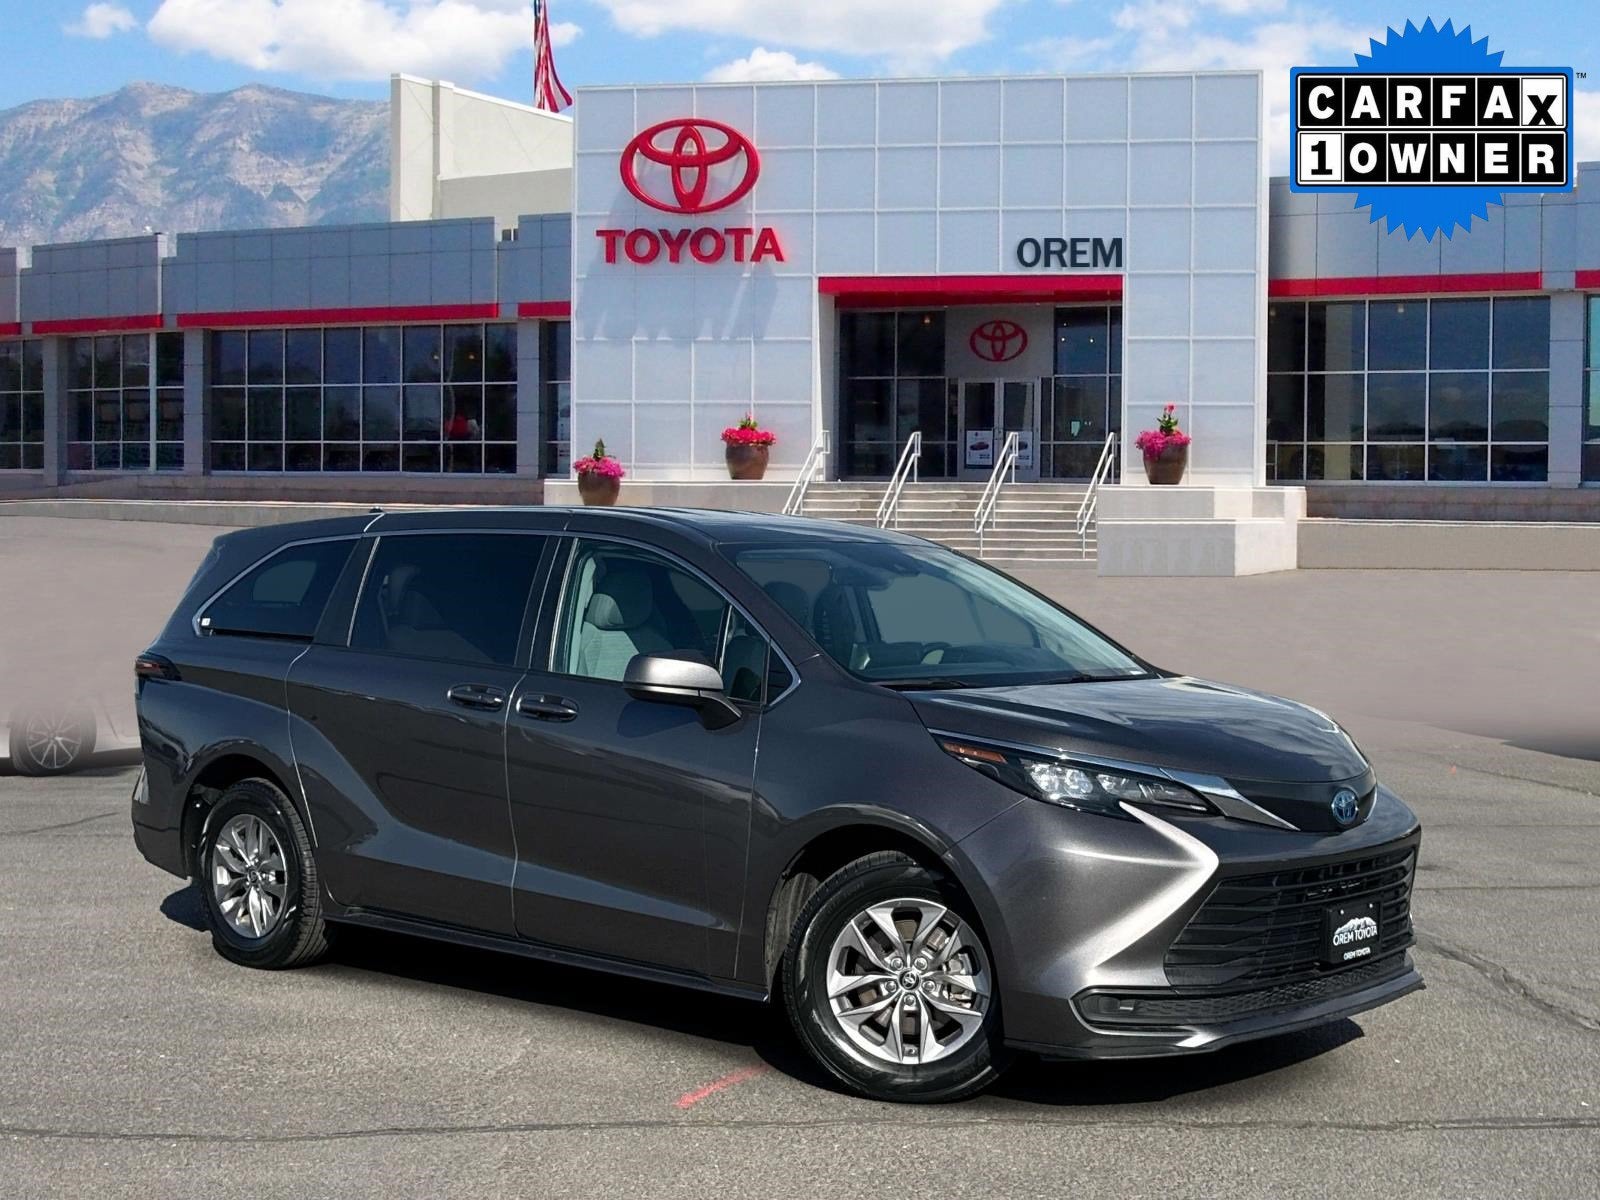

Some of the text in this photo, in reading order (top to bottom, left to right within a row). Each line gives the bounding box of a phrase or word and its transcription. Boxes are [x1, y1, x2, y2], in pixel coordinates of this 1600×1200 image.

[596, 227, 785, 264] TOYOTA
[1017, 237, 1123, 268] OREM
[1333, 925, 1378, 946] OREM TOYOTA
